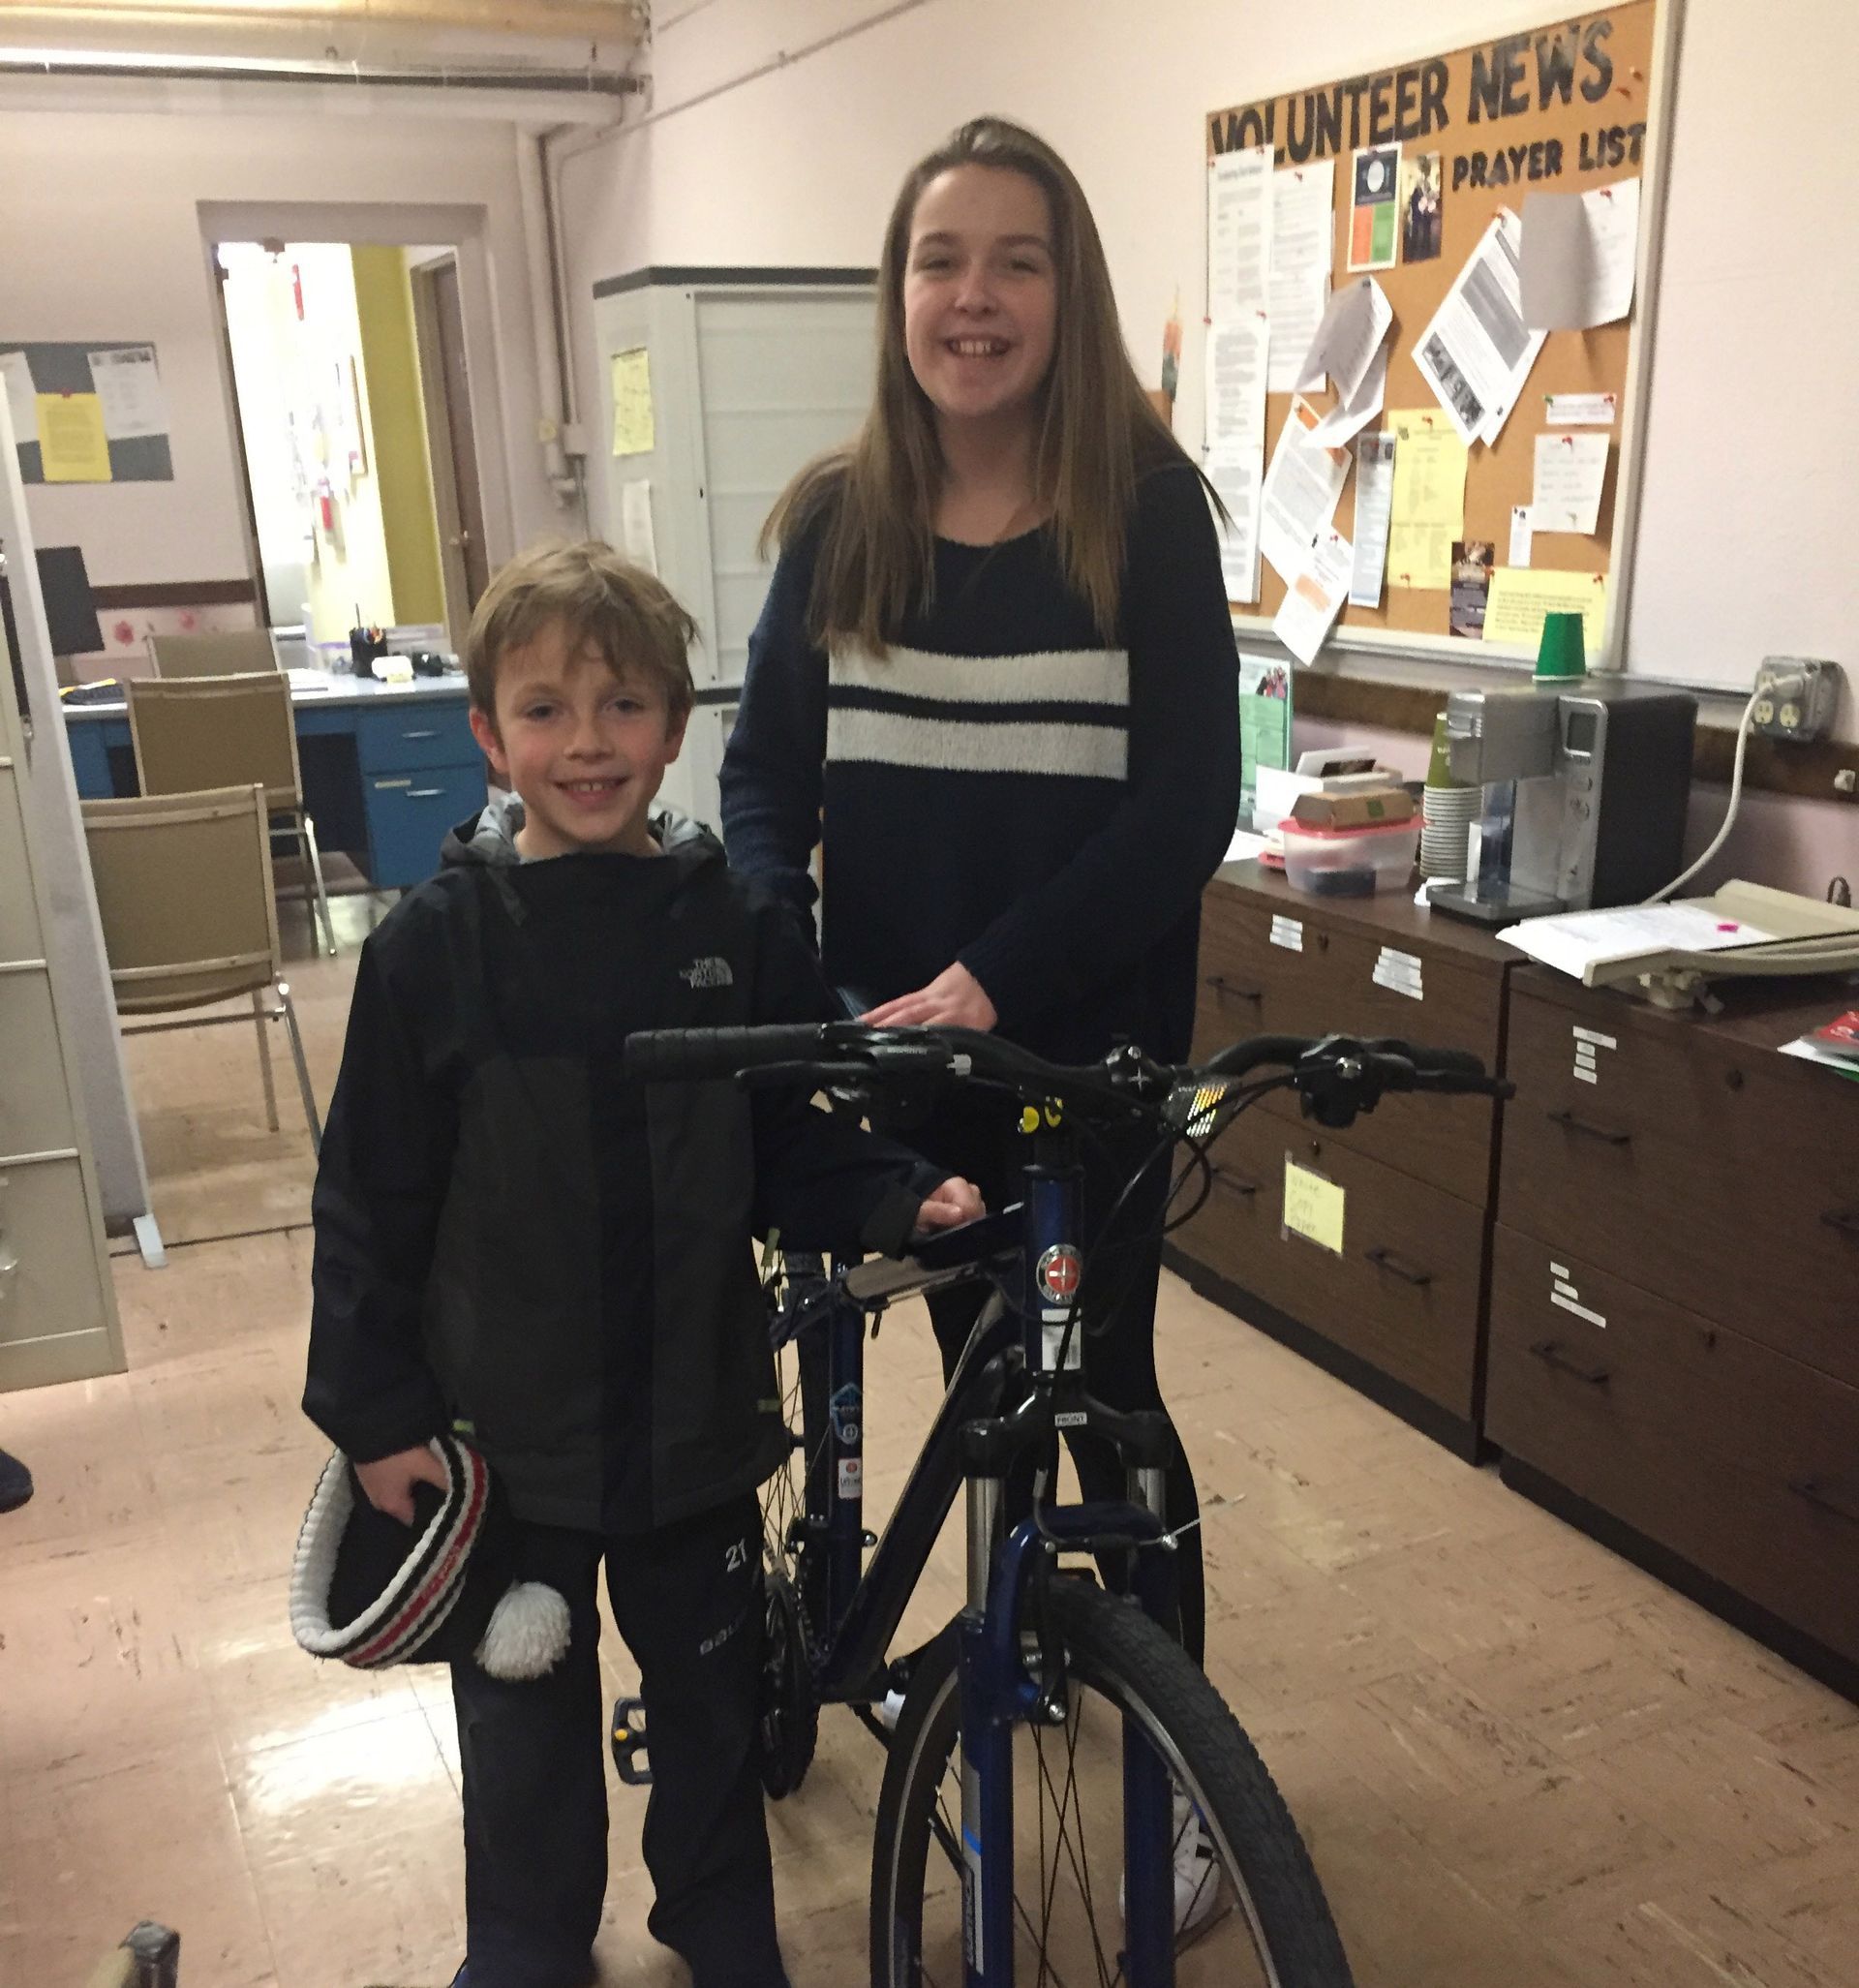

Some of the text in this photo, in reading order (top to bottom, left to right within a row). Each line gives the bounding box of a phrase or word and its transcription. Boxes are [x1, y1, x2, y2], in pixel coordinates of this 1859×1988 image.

[1212, 19, 1614, 166] VOLUNTEER NEWS
[1452, 121, 1646, 192] PRAYER LIST
[725, 1538, 747, 1573] 21
